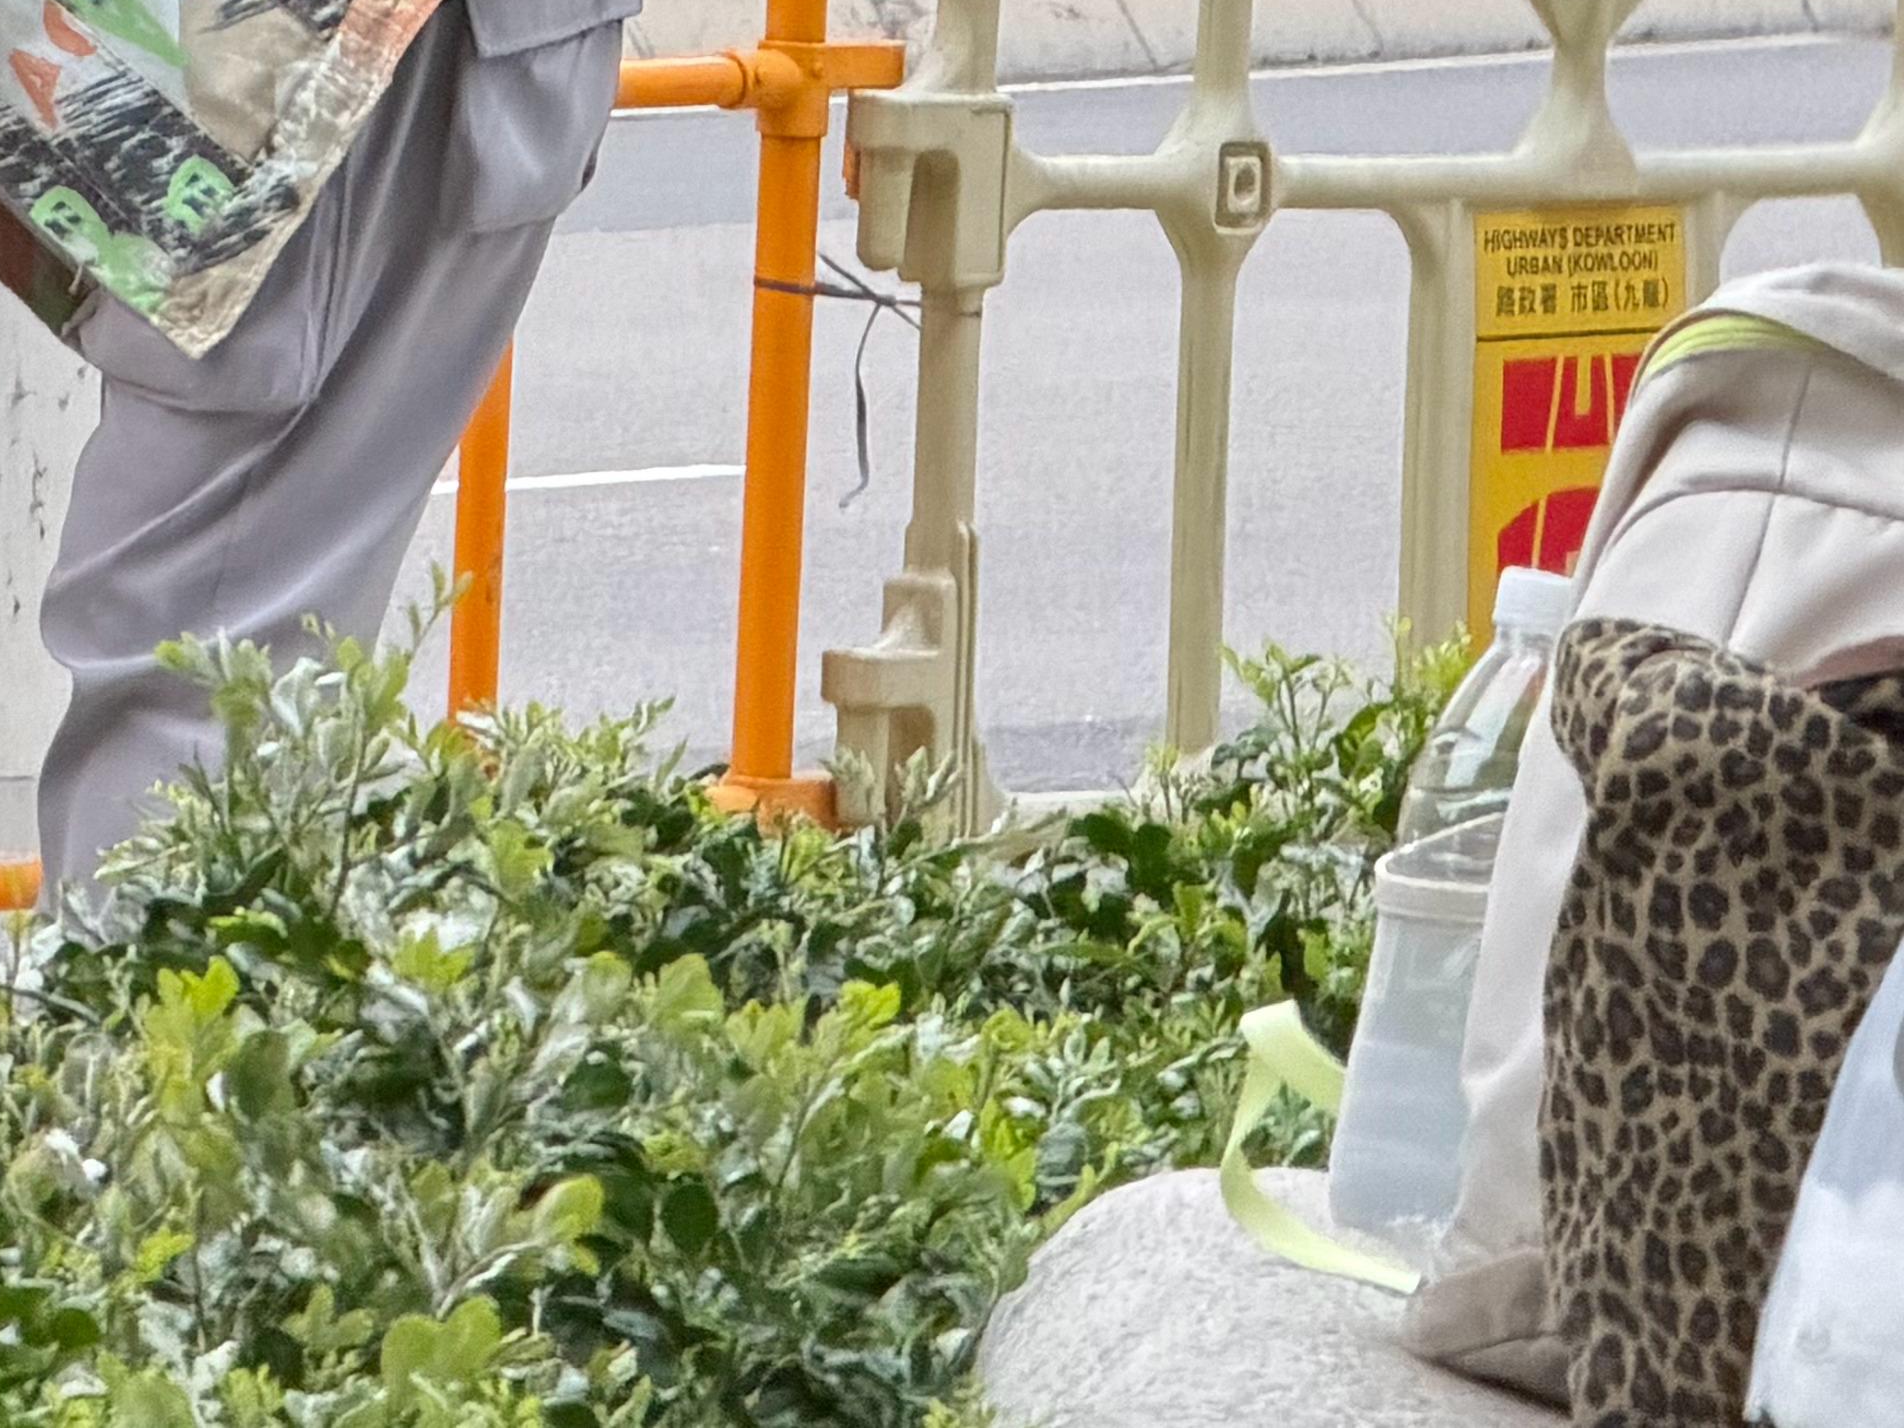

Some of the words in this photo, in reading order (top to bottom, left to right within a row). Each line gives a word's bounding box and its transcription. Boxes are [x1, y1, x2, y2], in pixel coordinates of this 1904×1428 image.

[1484, 226, 1568, 253] HIGHWAYS
[1573, 223, 1676, 247] DEPARTMENT
[1506, 255, 1564, 277] URBAN
[1567, 250, 1659, 278] (KOWLOON)
